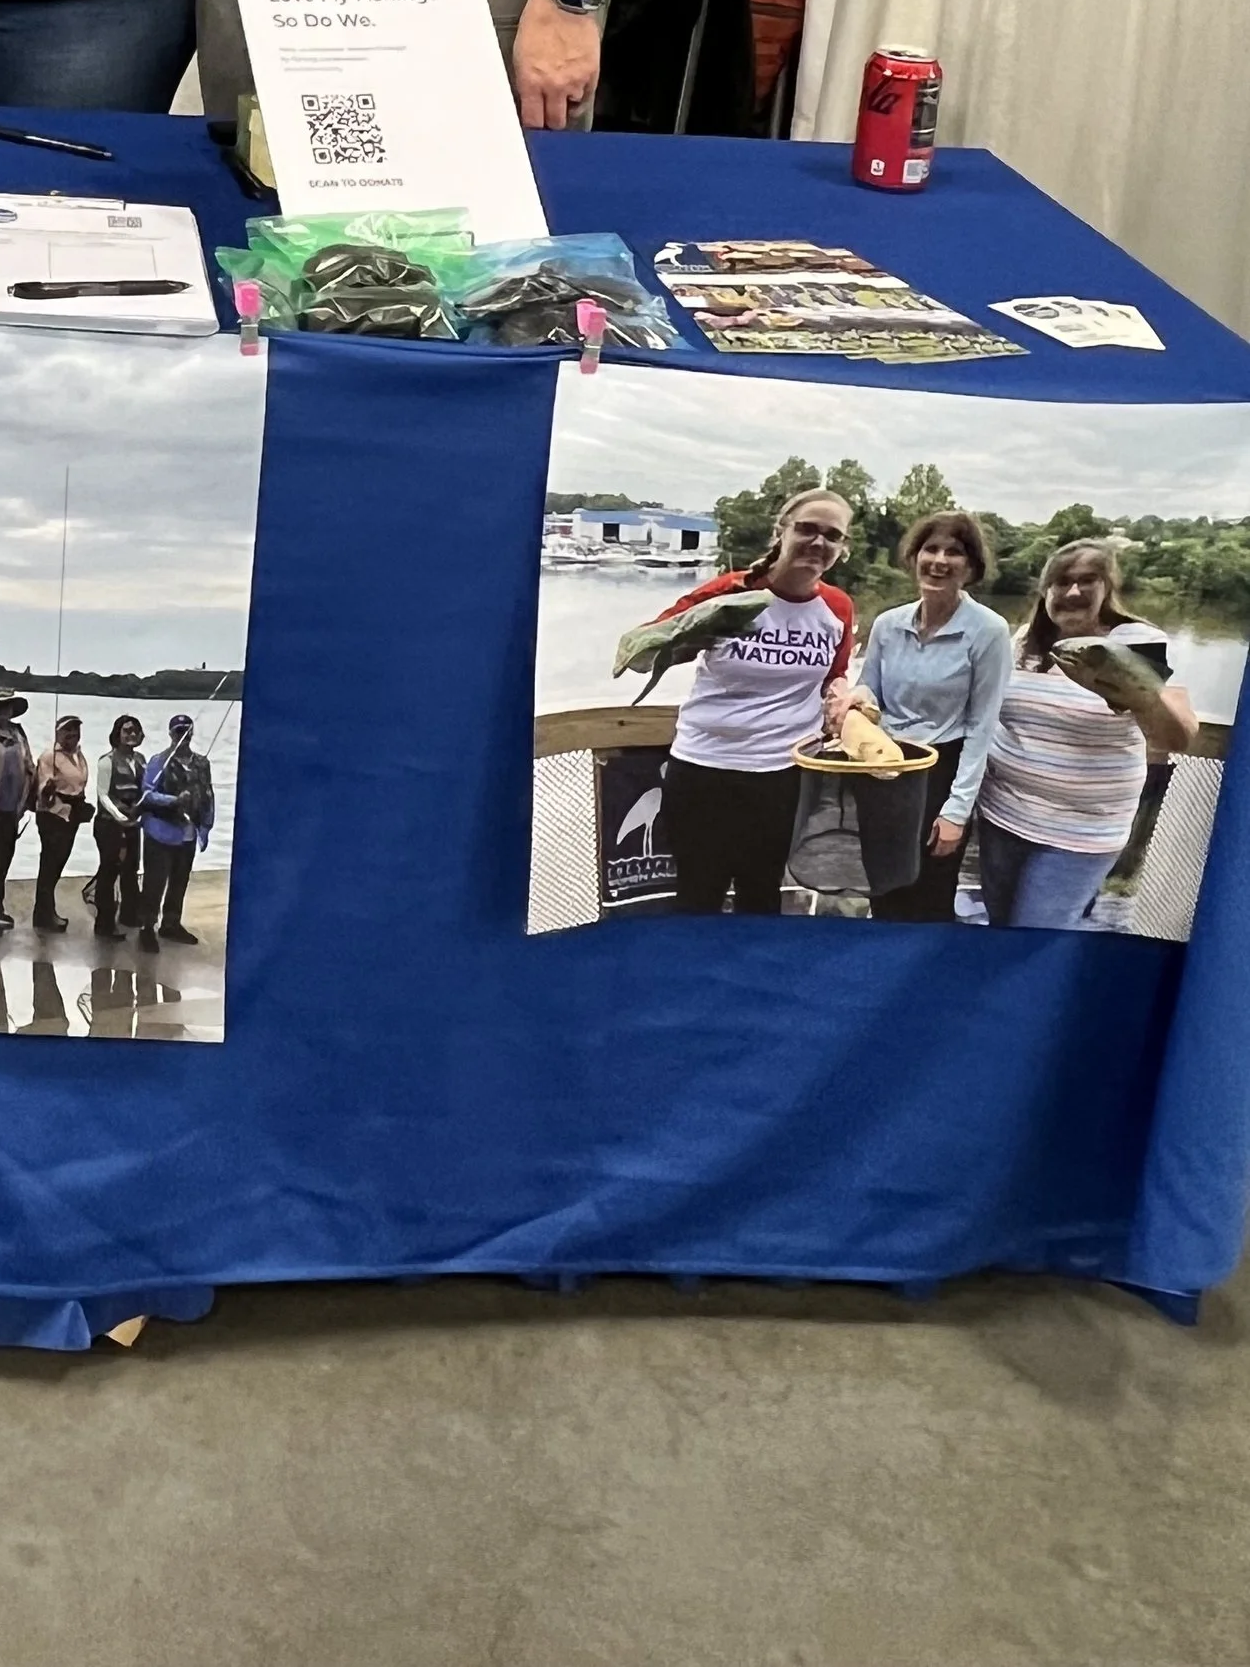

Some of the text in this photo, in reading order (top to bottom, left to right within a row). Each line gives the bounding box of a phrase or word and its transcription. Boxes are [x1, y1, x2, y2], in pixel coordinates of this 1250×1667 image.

[273, 13, 377, 28] So Do We.
